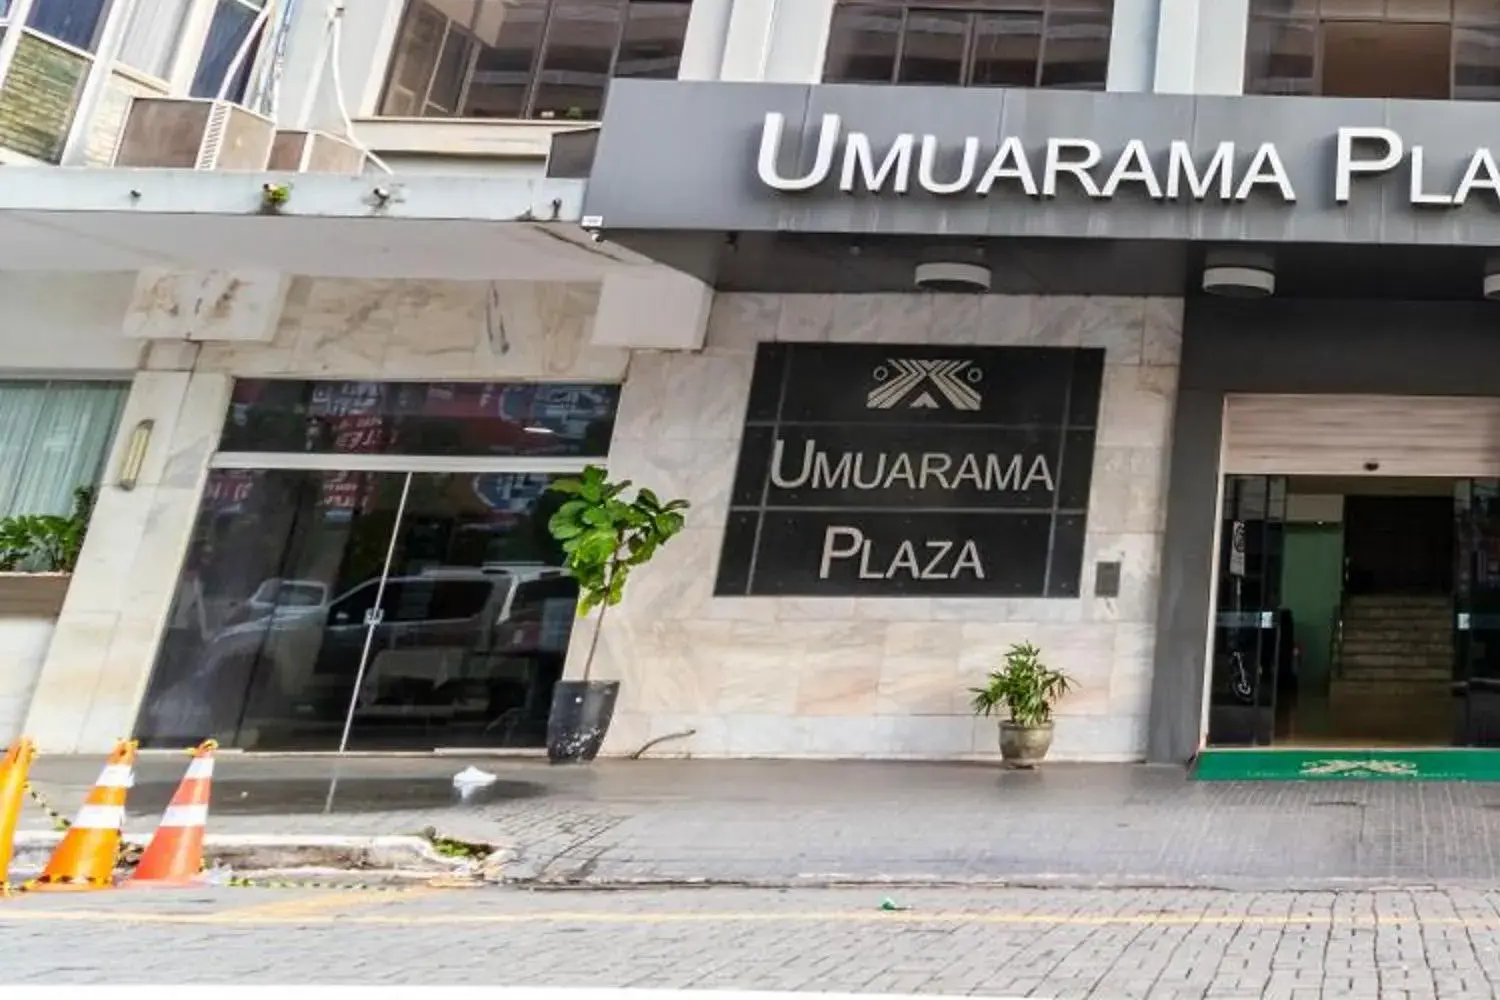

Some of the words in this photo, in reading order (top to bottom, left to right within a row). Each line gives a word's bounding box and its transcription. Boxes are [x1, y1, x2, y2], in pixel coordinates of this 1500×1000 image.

[756, 112, 1297, 202] UMUARAMA
[770, 438, 1055, 493] UMUARAMA
[819, 525, 986, 580] PLAZA
